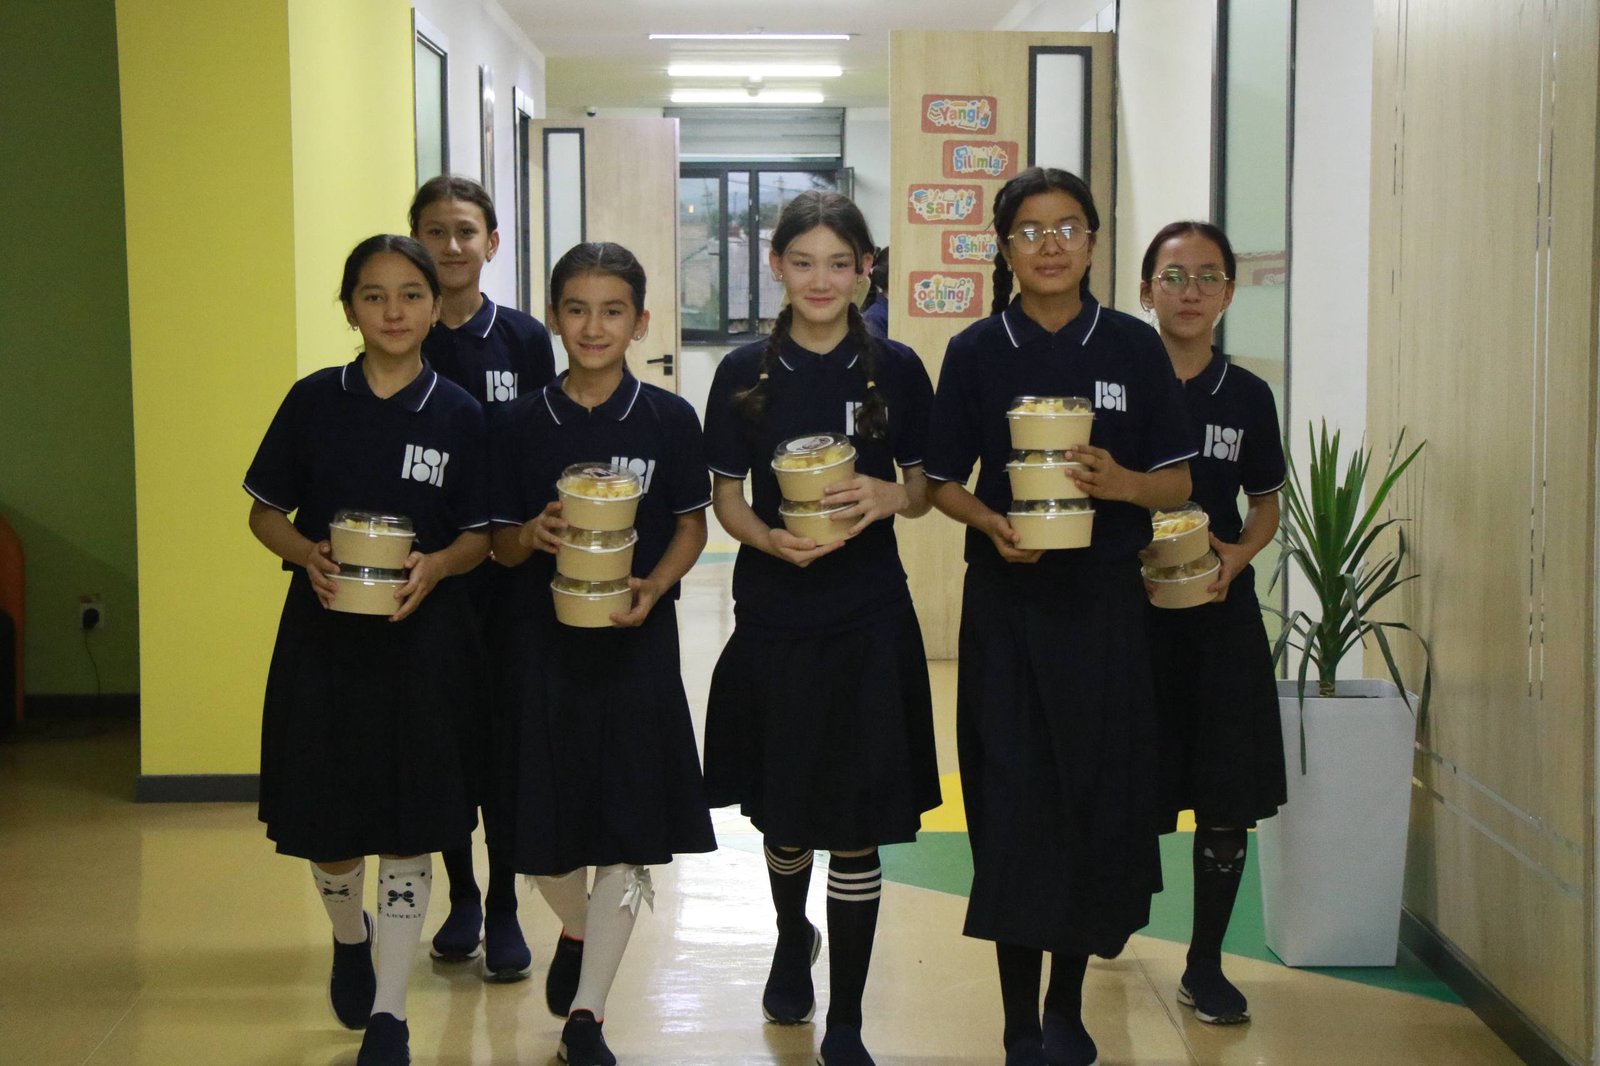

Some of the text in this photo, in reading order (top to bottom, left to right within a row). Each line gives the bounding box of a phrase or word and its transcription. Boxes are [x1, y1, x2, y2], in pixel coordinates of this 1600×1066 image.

[939, 105, 980, 123] Yangi
[954, 155, 1005, 170] bilimlar
[918, 287, 971, 303] oching!
